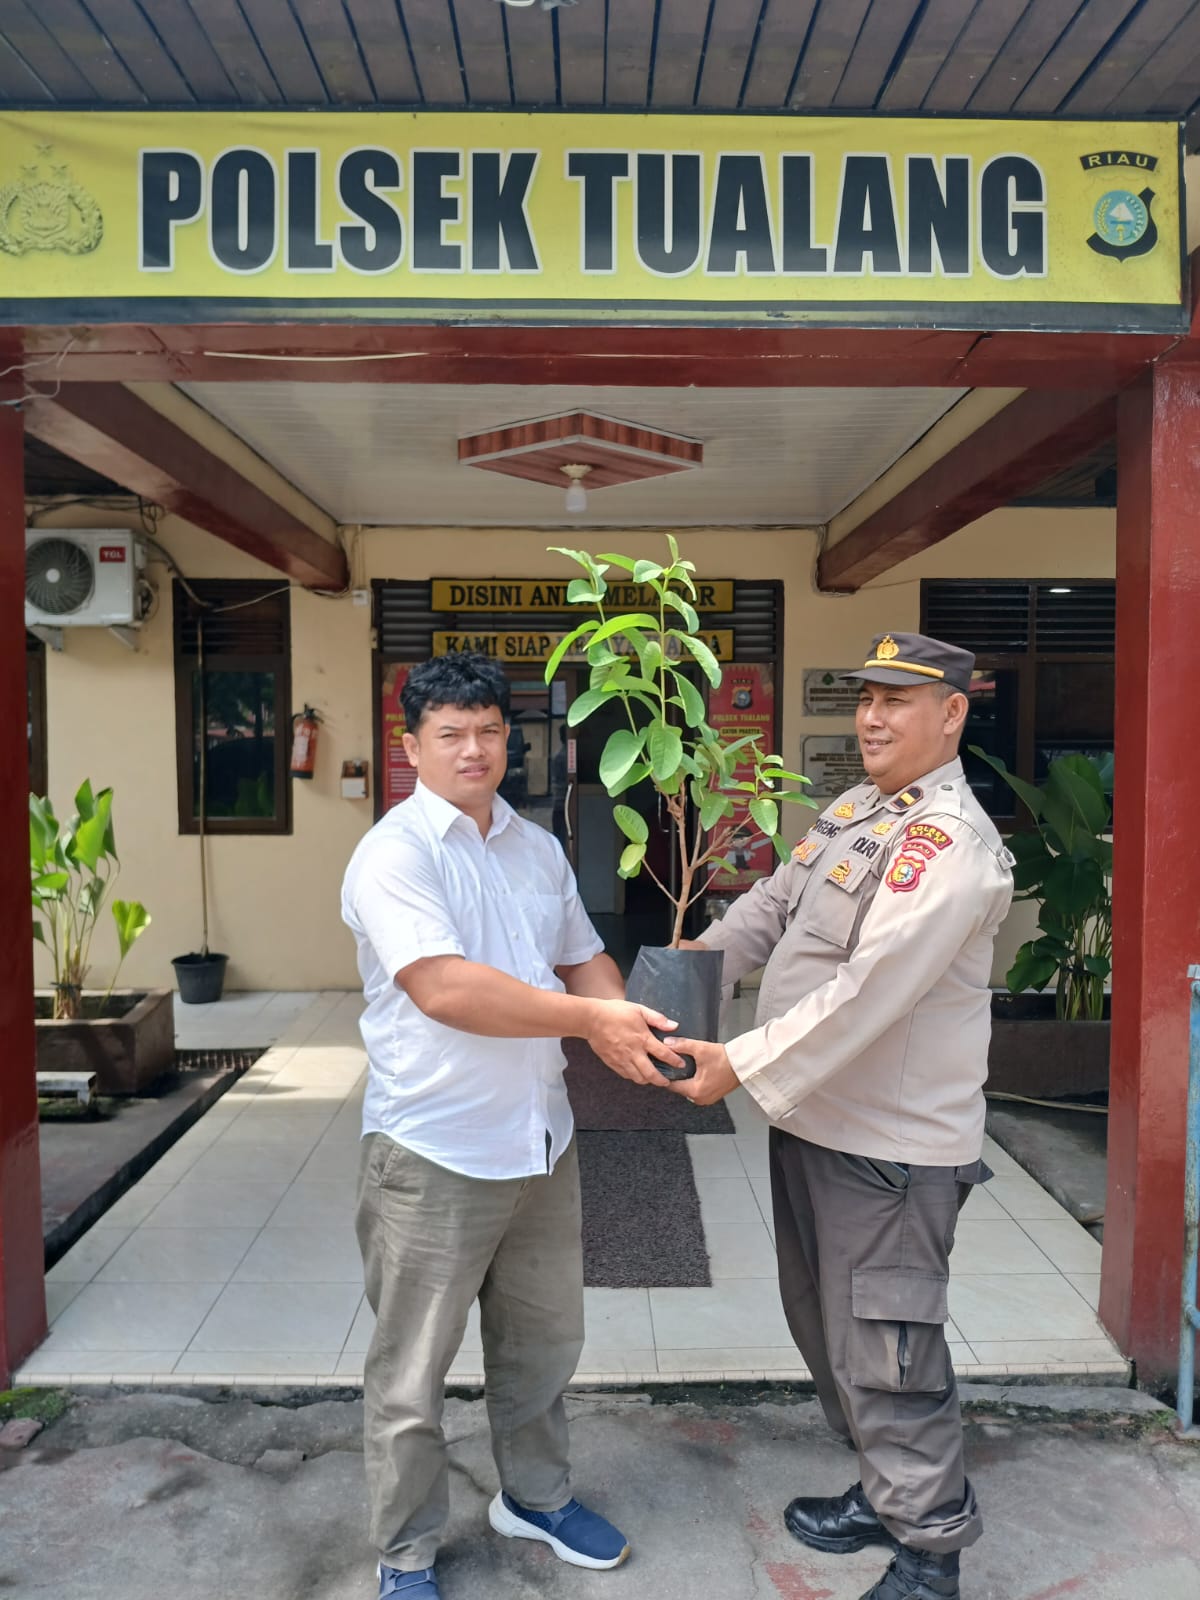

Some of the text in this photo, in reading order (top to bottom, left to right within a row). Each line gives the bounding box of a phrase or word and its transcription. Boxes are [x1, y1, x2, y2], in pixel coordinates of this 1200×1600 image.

[1088, 153, 1148, 167] RIAU
[140, 147, 1046, 279] POLSEK TUALANG
[449, 585, 523, 607] DISINI
[530, 585, 597, 607] AN
[446, 636, 498, 657] KAMI
[505, 636, 550, 657] SIAP
